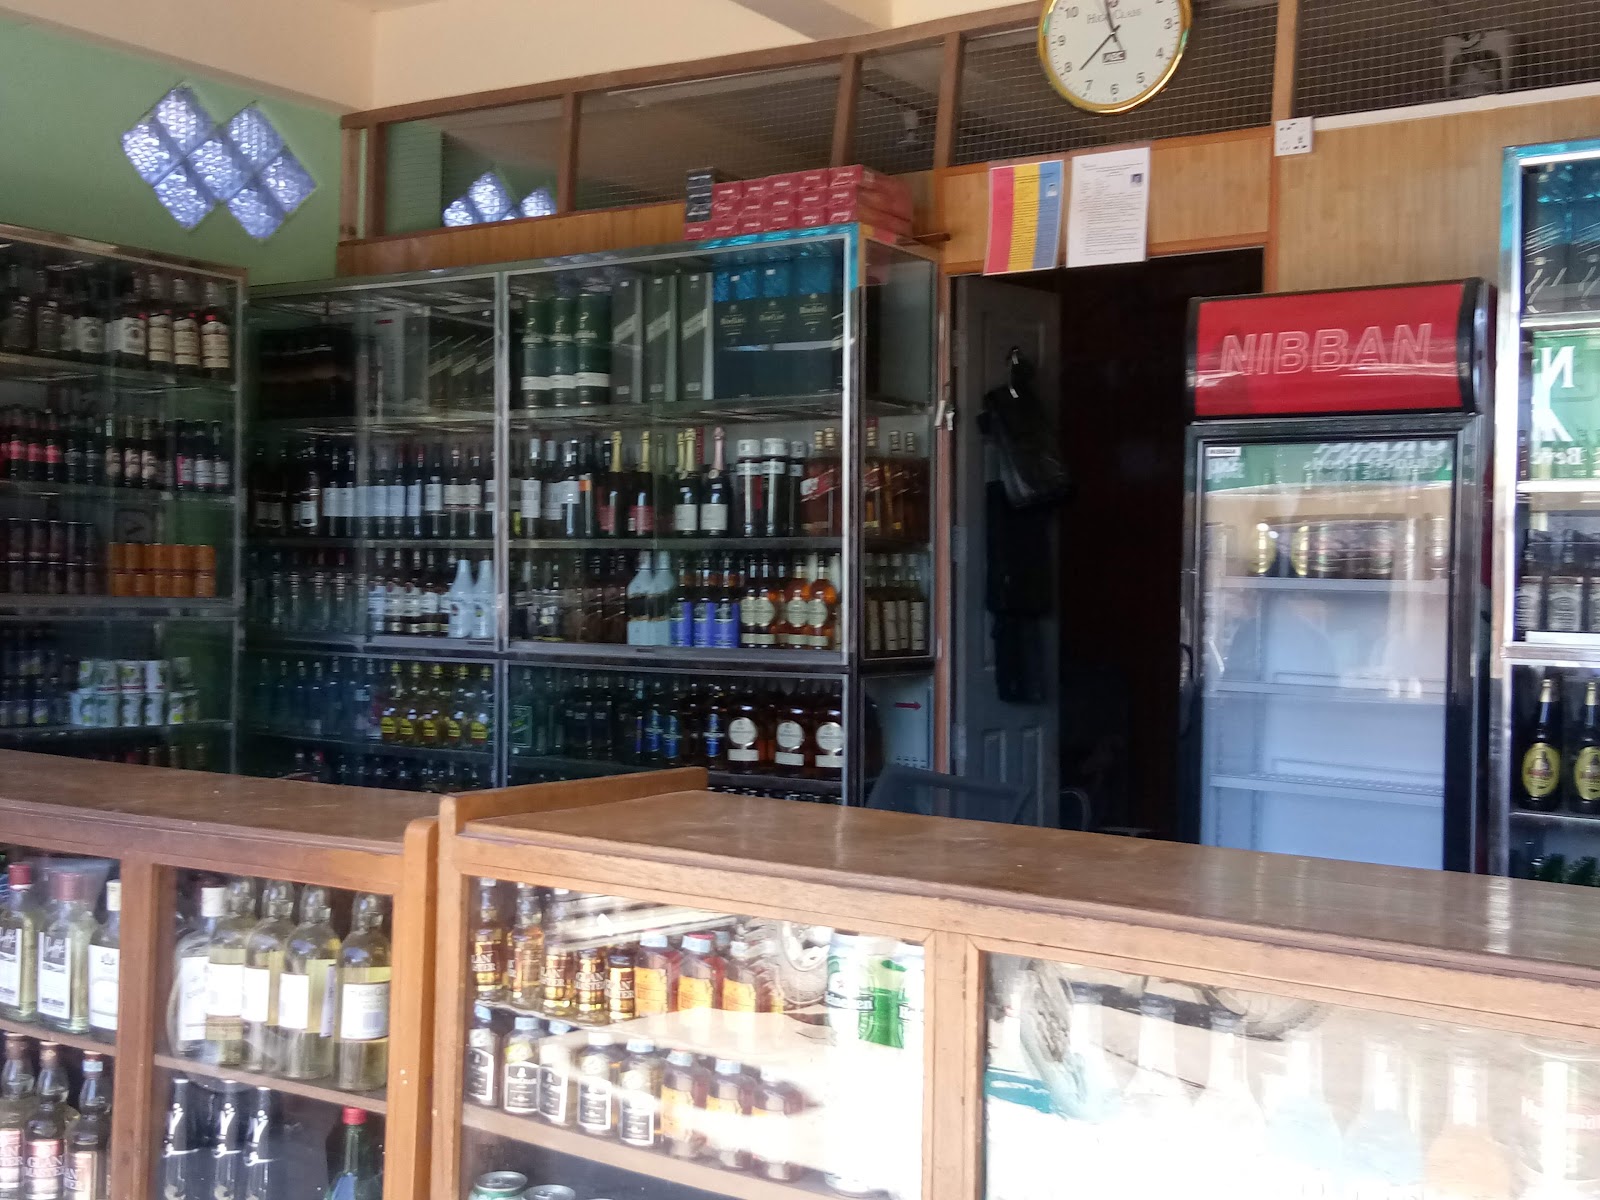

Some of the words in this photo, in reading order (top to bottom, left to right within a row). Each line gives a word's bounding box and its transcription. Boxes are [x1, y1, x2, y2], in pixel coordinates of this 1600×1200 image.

[1065, 6, 1080, 19] 10
[1164, 18, 1173, 30] 3
[1058, 35, 1066, 47] 9
[1155, 47, 1164, 58] 4
[1064, 61, 1073, 73] 8
[1136, 72, 1145, 84] 5
[1084, 79, 1094, 91] 7
[1110, 83, 1119, 95] 6
[1219, 322, 1432, 376] NIBBAN
